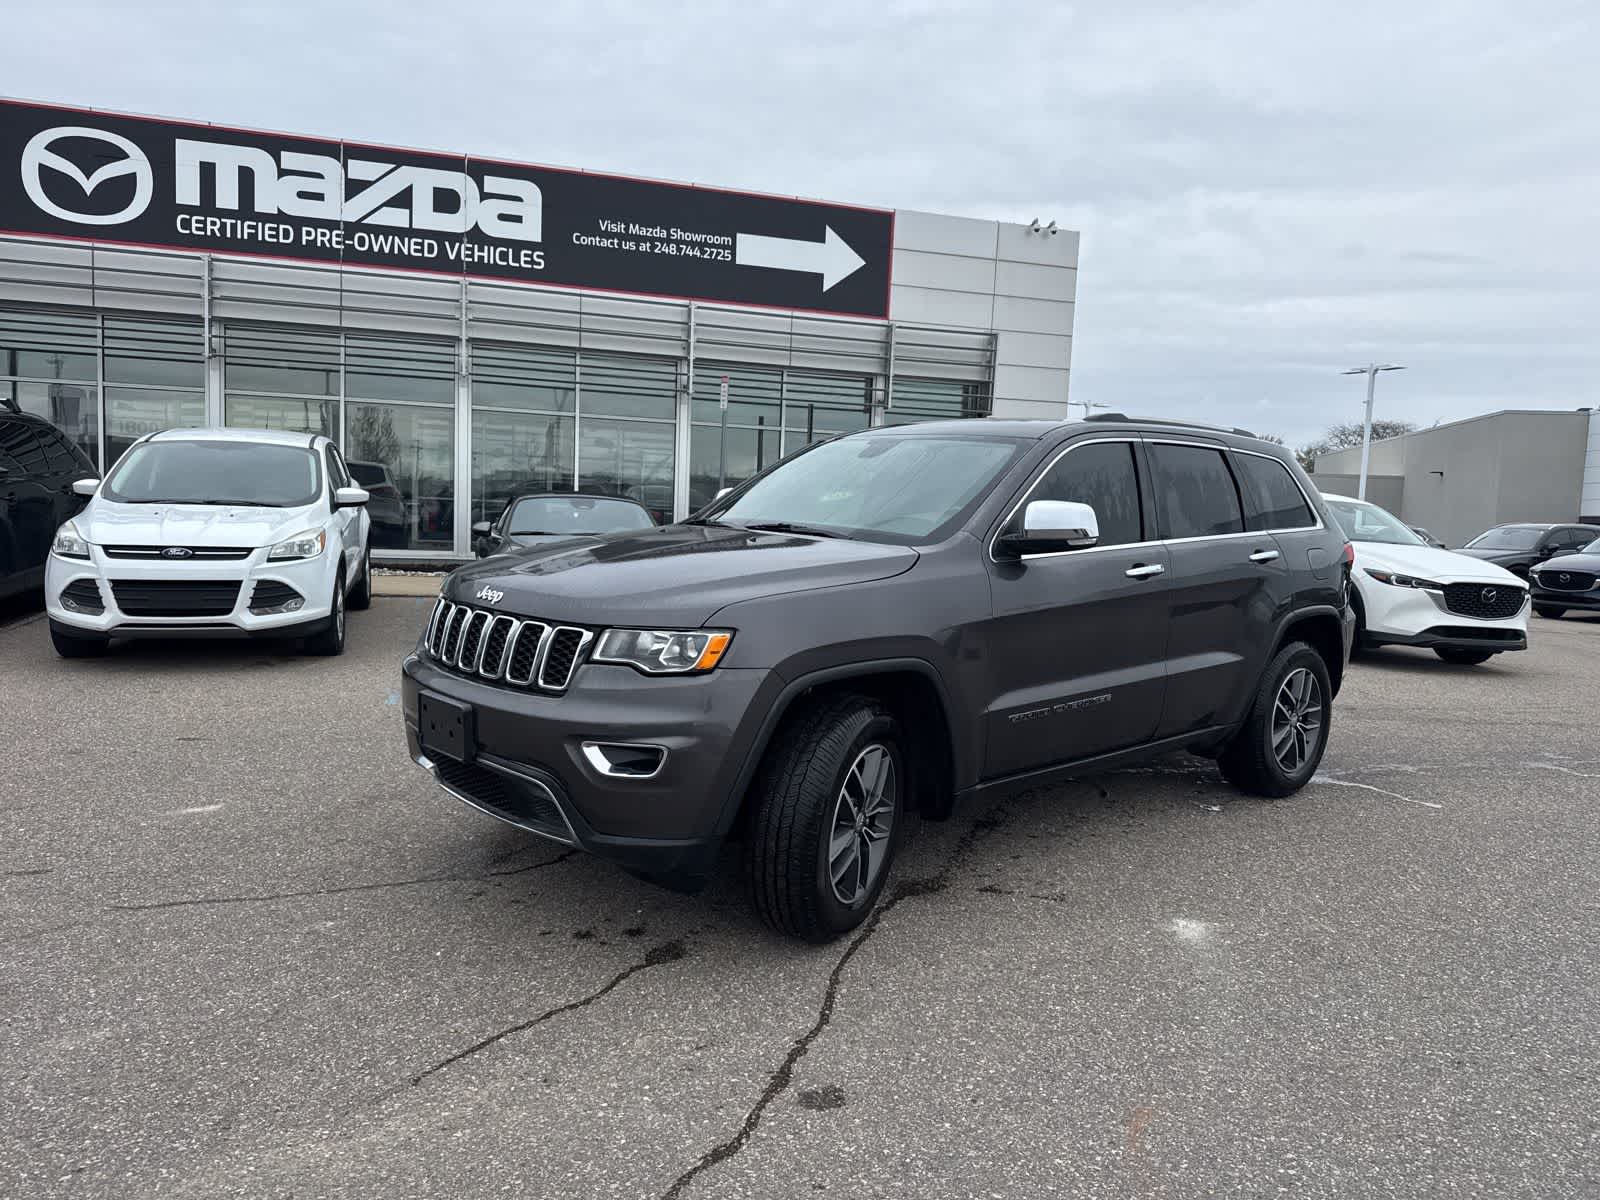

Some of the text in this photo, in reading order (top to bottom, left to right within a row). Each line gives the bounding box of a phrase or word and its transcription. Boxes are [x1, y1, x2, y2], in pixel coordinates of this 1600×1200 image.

[176, 214, 545, 270] CERTIFIED PRE-OWNED VEHICLES
[599, 219, 732, 246] Visit Mazda Showroom
[572, 232, 732, 262] Contact us at 248.744.2725
[476, 585, 504, 605] Jeep
